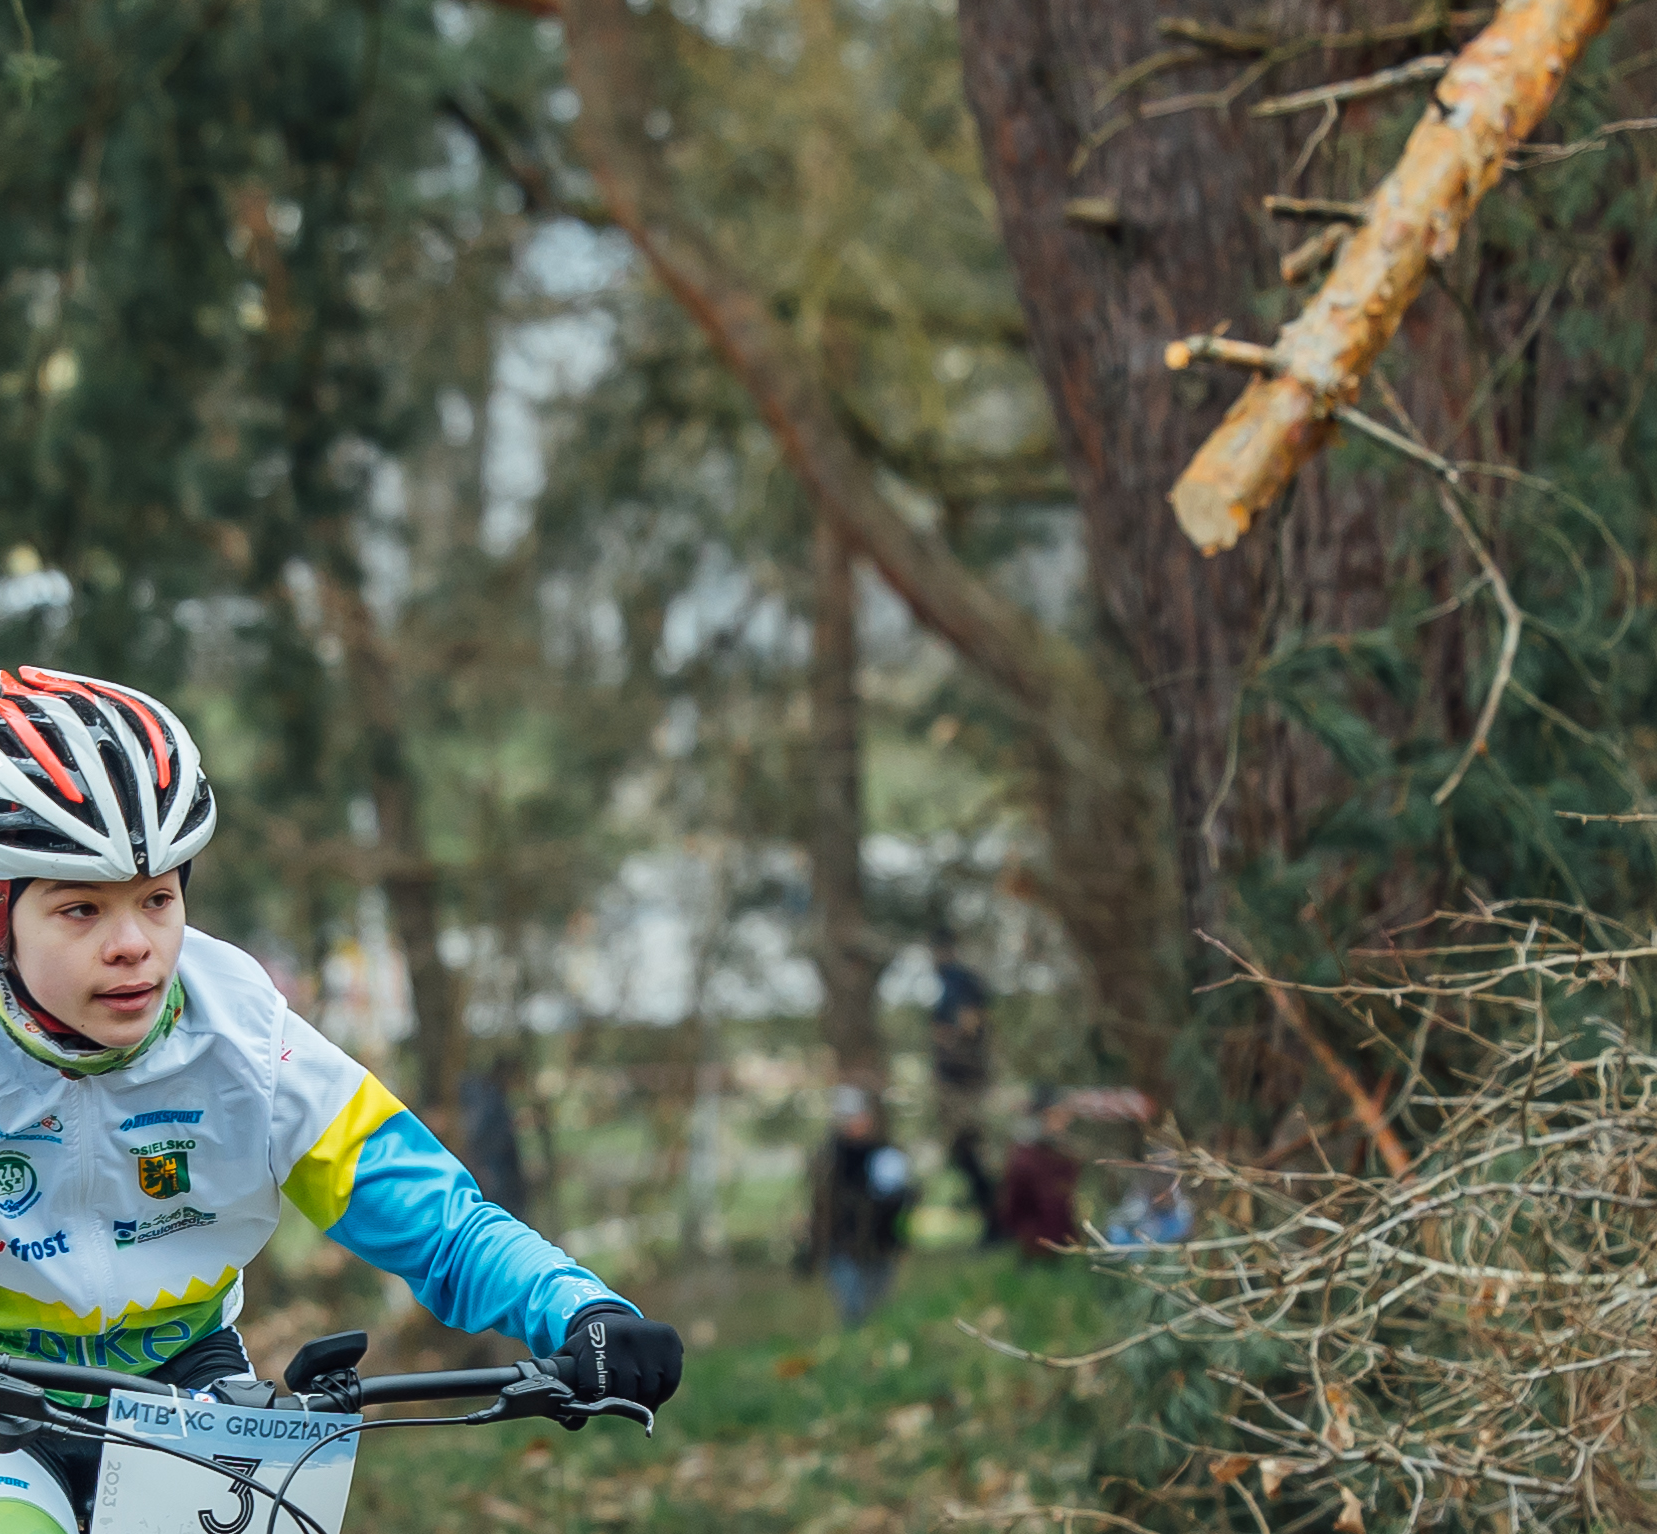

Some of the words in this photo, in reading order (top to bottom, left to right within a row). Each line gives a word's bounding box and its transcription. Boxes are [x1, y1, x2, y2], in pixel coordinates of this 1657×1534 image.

[129, 1139, 196, 1156] OSIELSKO
[115, 1400, 170, 1426] MTB
[183, 1409, 215, 1432] XC
[102, 1460, 122, 1508] 2023
